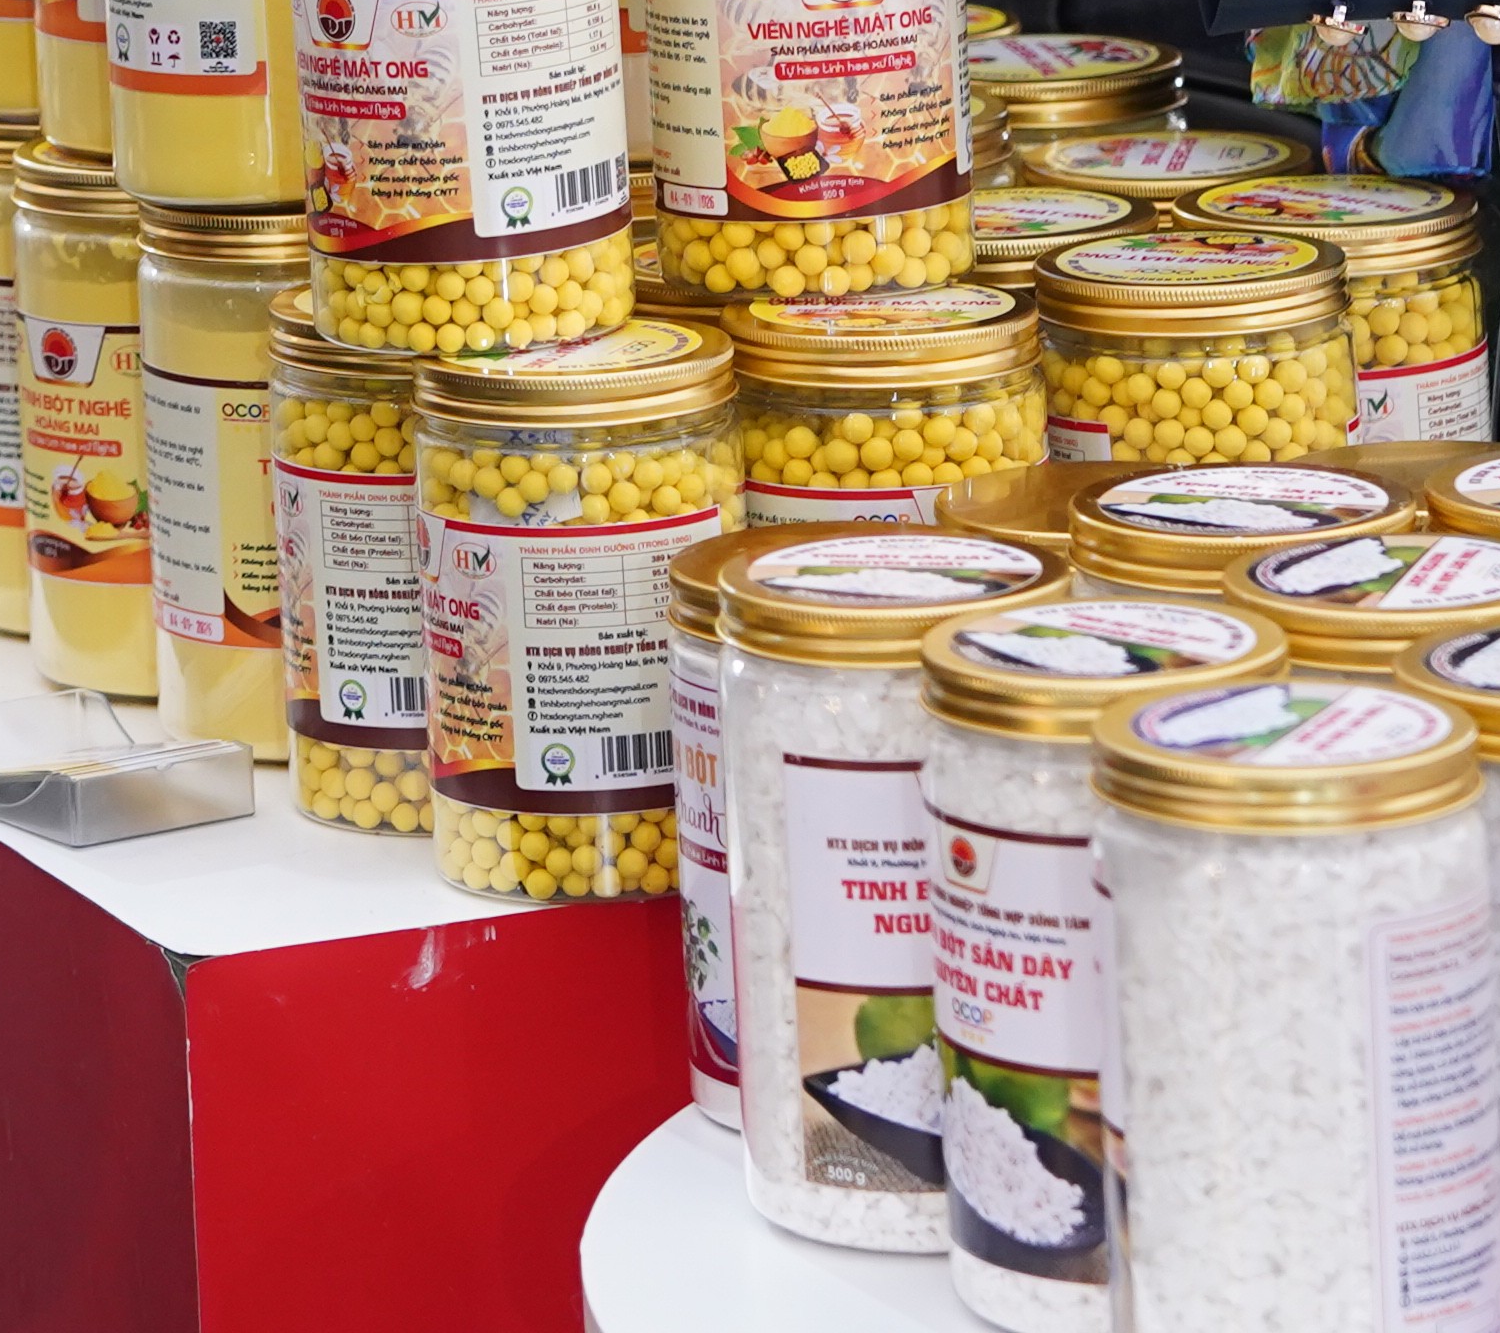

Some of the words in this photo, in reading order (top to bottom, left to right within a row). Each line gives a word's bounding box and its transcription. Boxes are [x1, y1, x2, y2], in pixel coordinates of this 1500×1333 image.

[747, 19, 793, 40] VIÊN
[797, 15, 850, 39] NGHỆ
[854, 6, 896, 36] MẬT
[900, 6, 933, 29] ONG
[344, 55, 383, 82] MẬT
[386, 60, 429, 79] ONG
[79, 397, 132, 420] NGHỆ
[450, 598, 480, 620] ONG
[841, 879, 908, 901] TINH
[873, 913, 932, 934] NGU
[827, 1164, 853, 1181] 500
